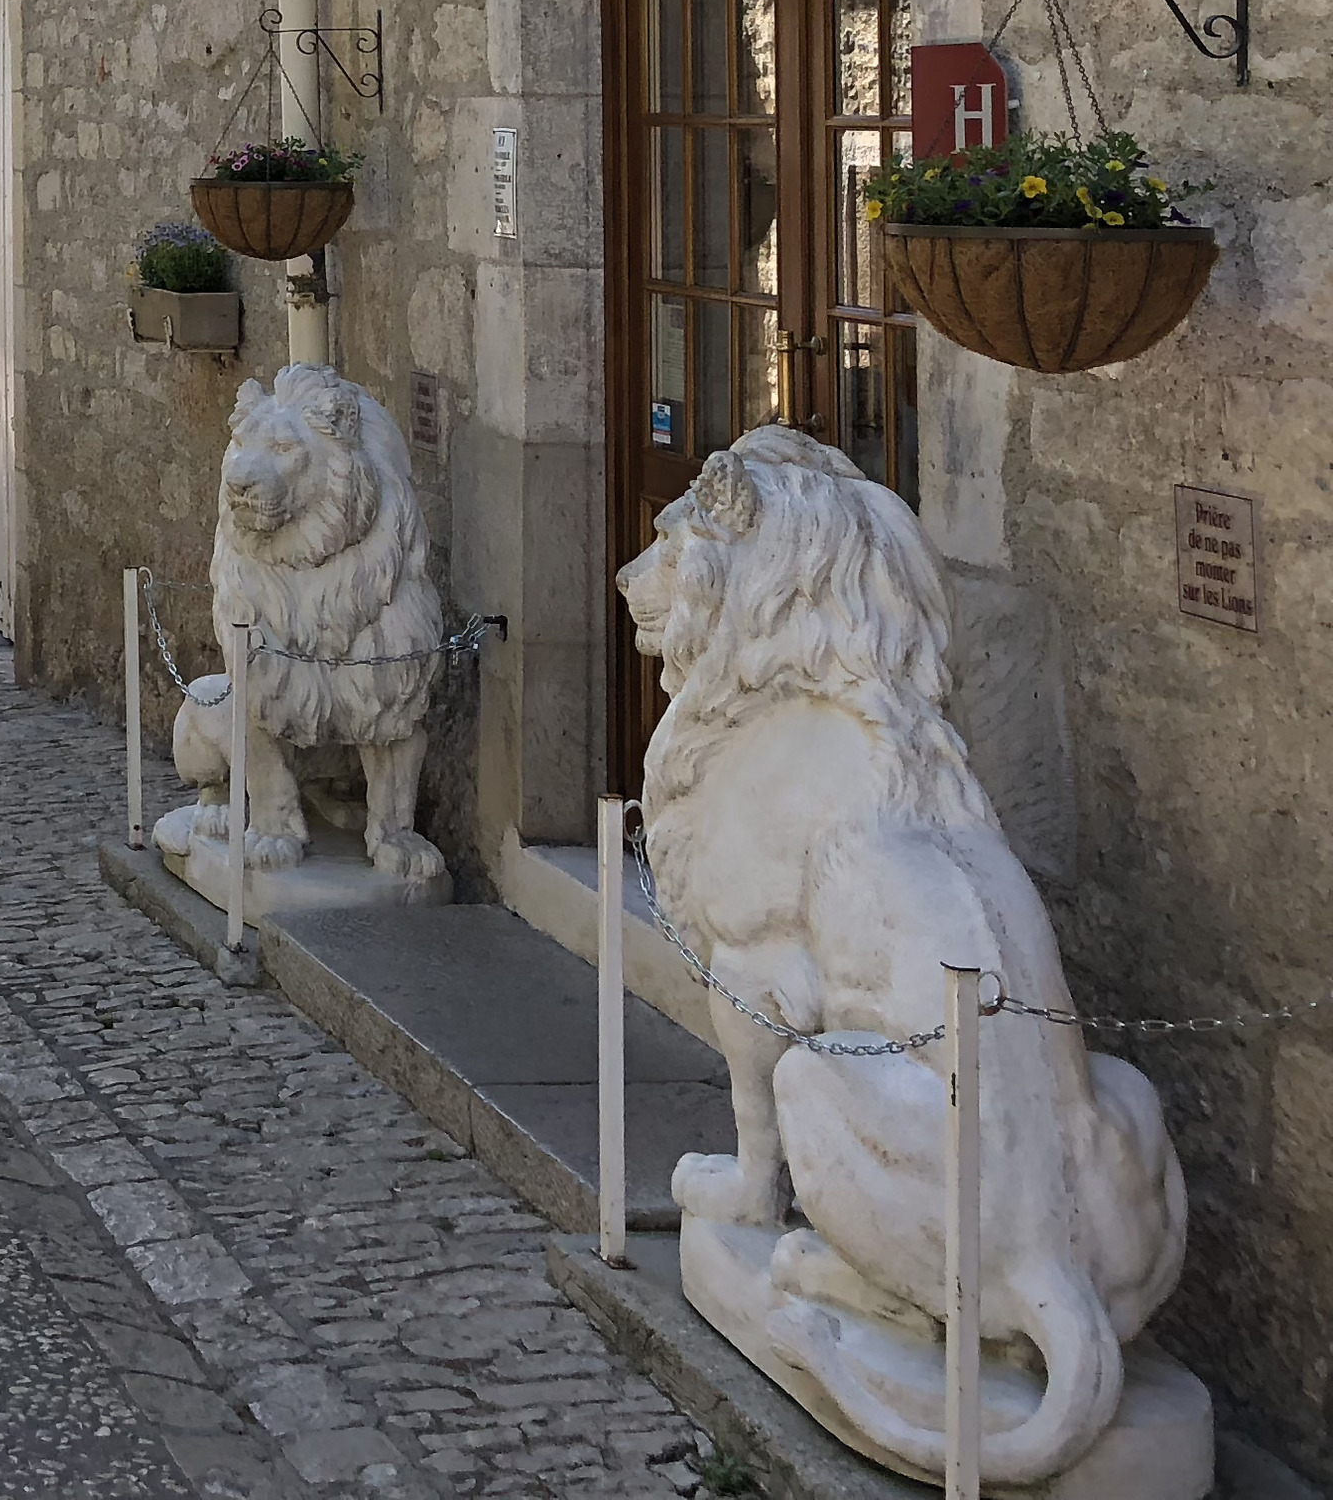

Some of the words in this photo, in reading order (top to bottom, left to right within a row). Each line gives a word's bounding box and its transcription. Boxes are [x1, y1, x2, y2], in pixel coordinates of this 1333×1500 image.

[949, 83, 996, 154] H
[1188, 529, 1202, 550] de
[1204, 536, 1219, 554] ne
[1221, 540, 1242, 561] pas
[1183, 583, 1200, 603] sur
[1202, 583, 1219, 607] les
